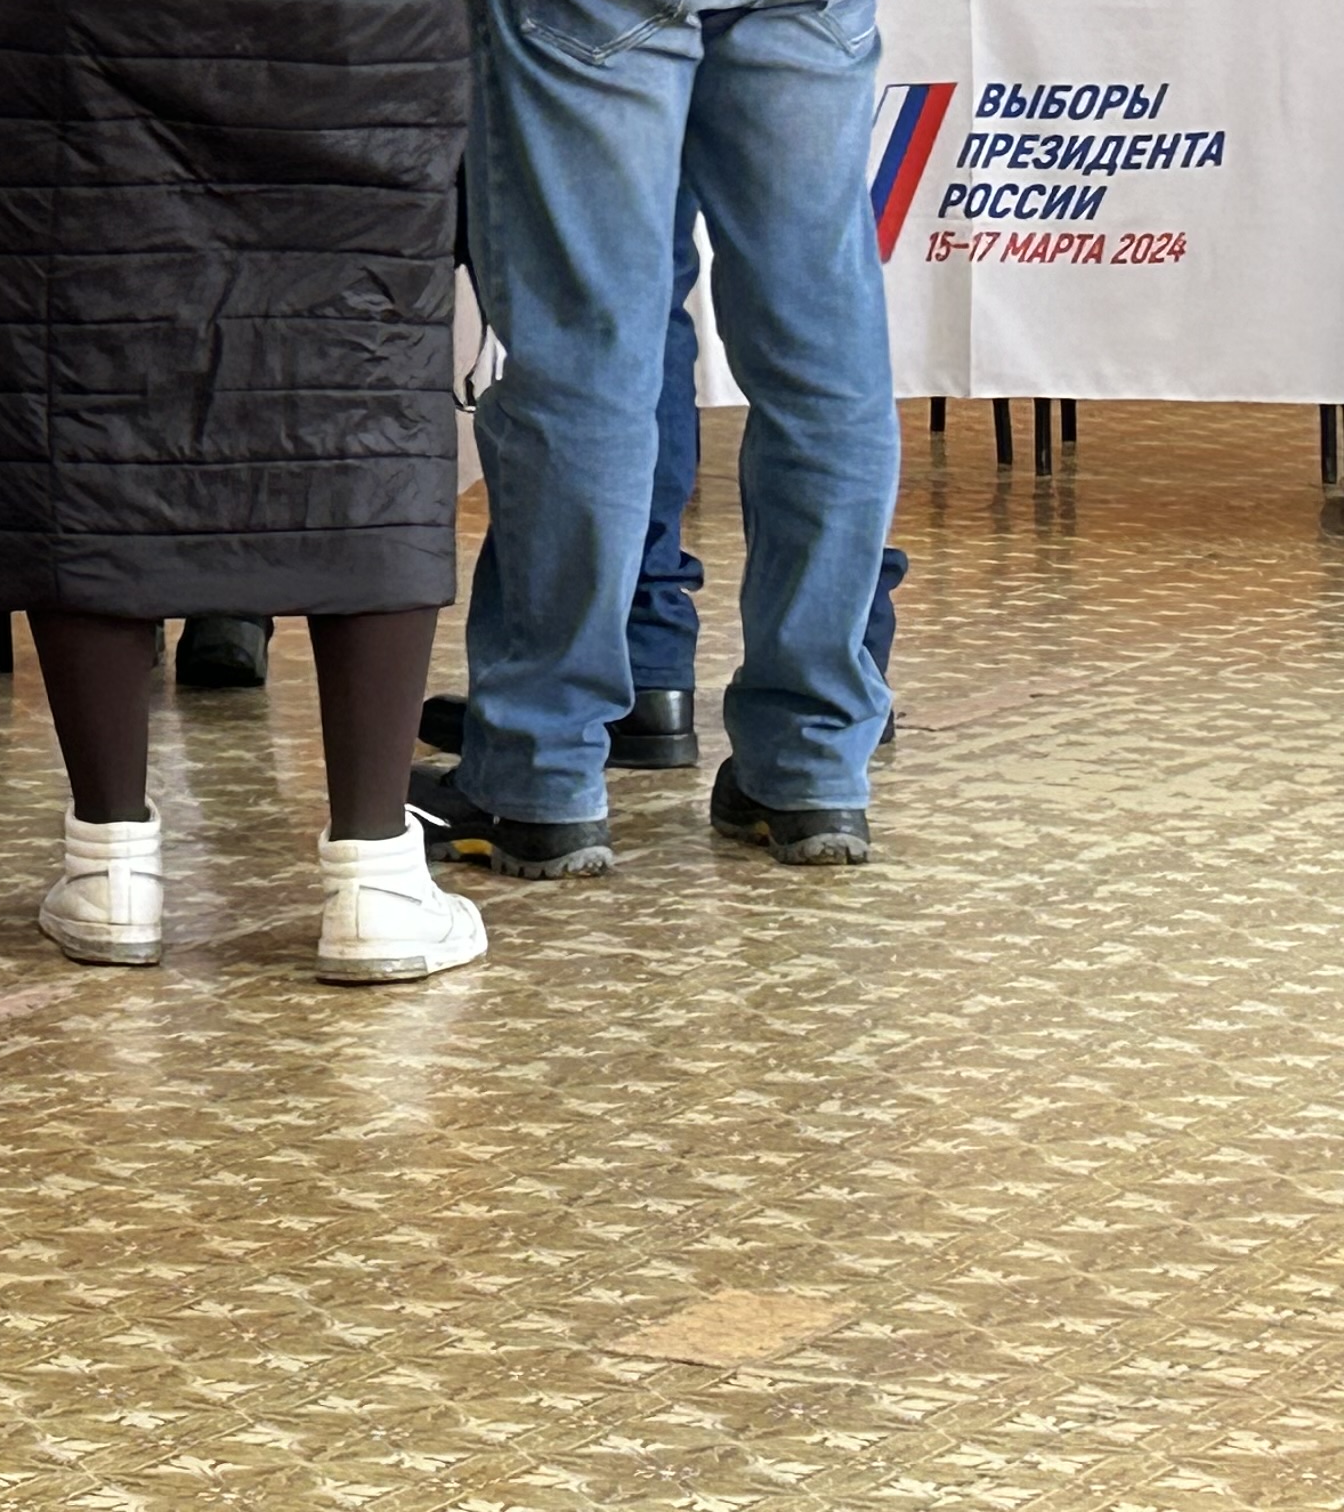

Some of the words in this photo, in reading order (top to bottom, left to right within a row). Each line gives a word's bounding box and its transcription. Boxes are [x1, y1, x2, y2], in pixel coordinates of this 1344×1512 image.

[975, 83, 1169, 120] ВЫБОРЫ
[957, 131, 1225, 176] ПРЕЗИДЕНТА
[938, 183, 1107, 220] РОССИИ
[1000, 232, 1107, 263] МАРТА
[1111, 232, 1187, 264] 2024
